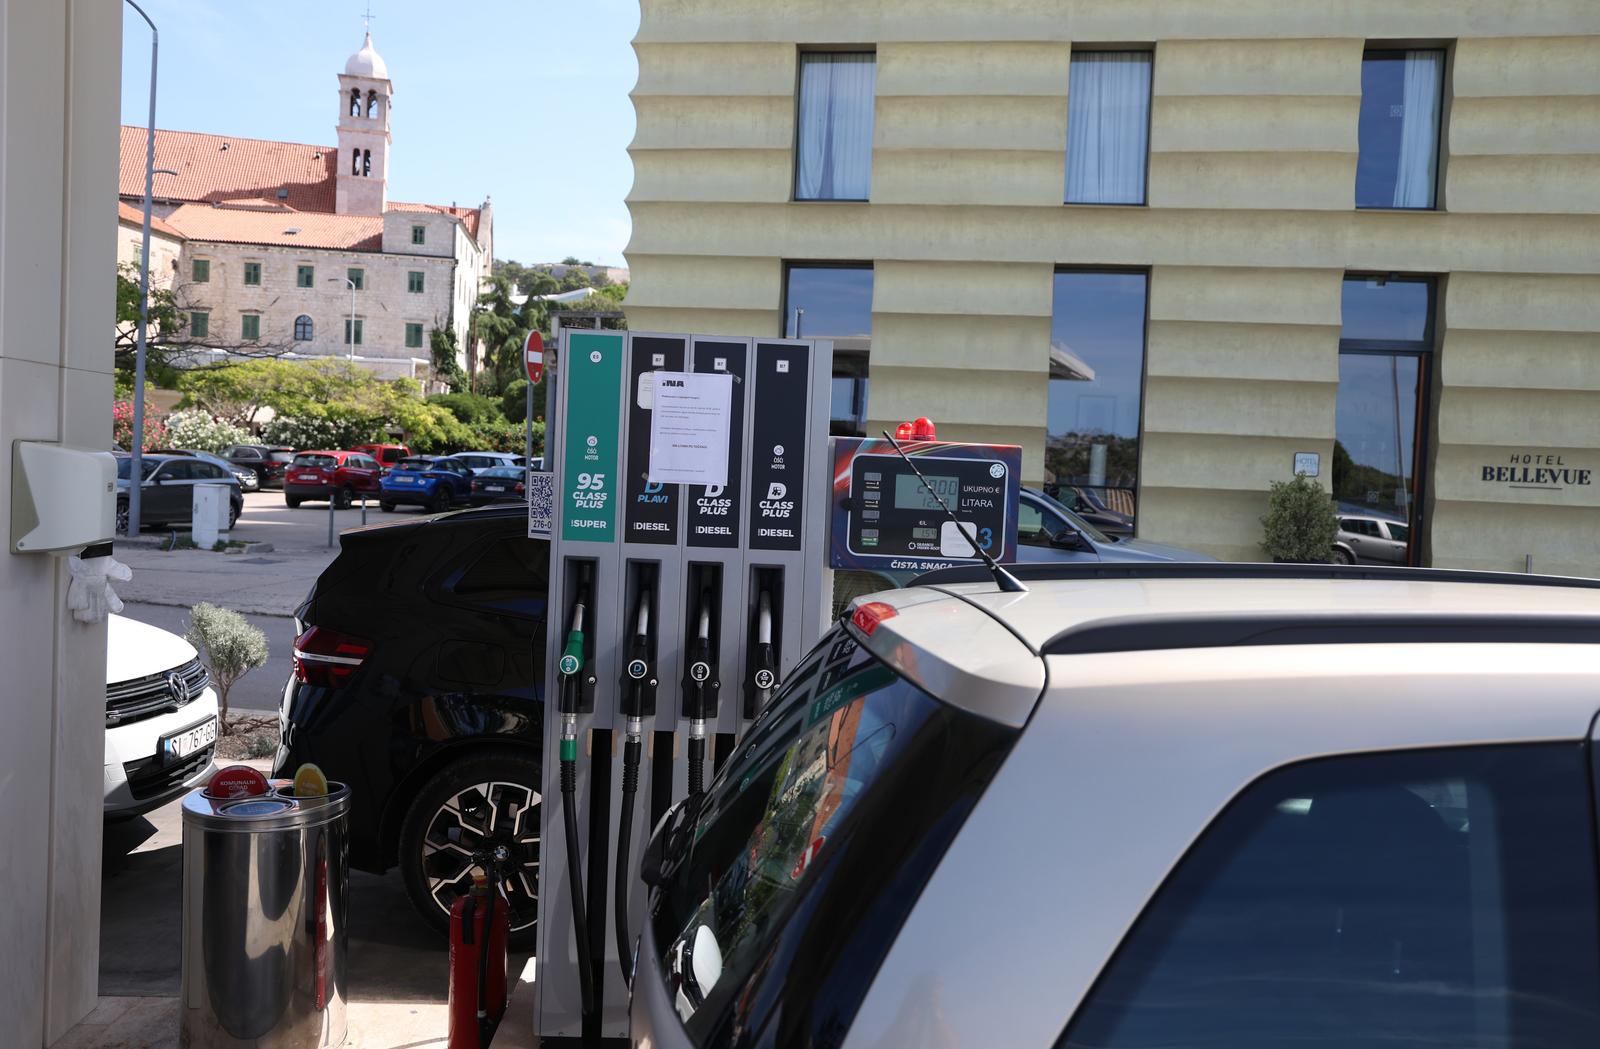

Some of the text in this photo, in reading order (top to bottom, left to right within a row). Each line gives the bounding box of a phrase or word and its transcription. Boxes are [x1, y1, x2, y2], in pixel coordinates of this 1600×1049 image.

[1510, 454, 1565, 466] HOTEL
[1481, 466, 1592, 485] BELLEVUE
[576, 472, 605, 490] 95
[704, 484, 725, 498] D
[767, 482, 787, 500] D
[963, 485, 994, 494] UKUPNO
[572, 491, 608, 501] CLASS
[637, 494, 669, 504] PLAVI
[575, 500, 604, 509] PLUS
[696, 498, 732, 507] CLASS
[759, 501, 794, 510] CLASS
[961, 498, 993, 508] LITARA
[699, 506, 728, 516] PLUS
[762, 509, 790, 518] PLUS
[573, 520, 607, 529] SUPER
[635, 522, 670, 532] DIESEL
[697, 525, 732, 535] DIESEL
[760, 528, 794, 538] DIESEL
[980, 527, 993, 550] 3
[890, 559, 918, 570] ČISTA
